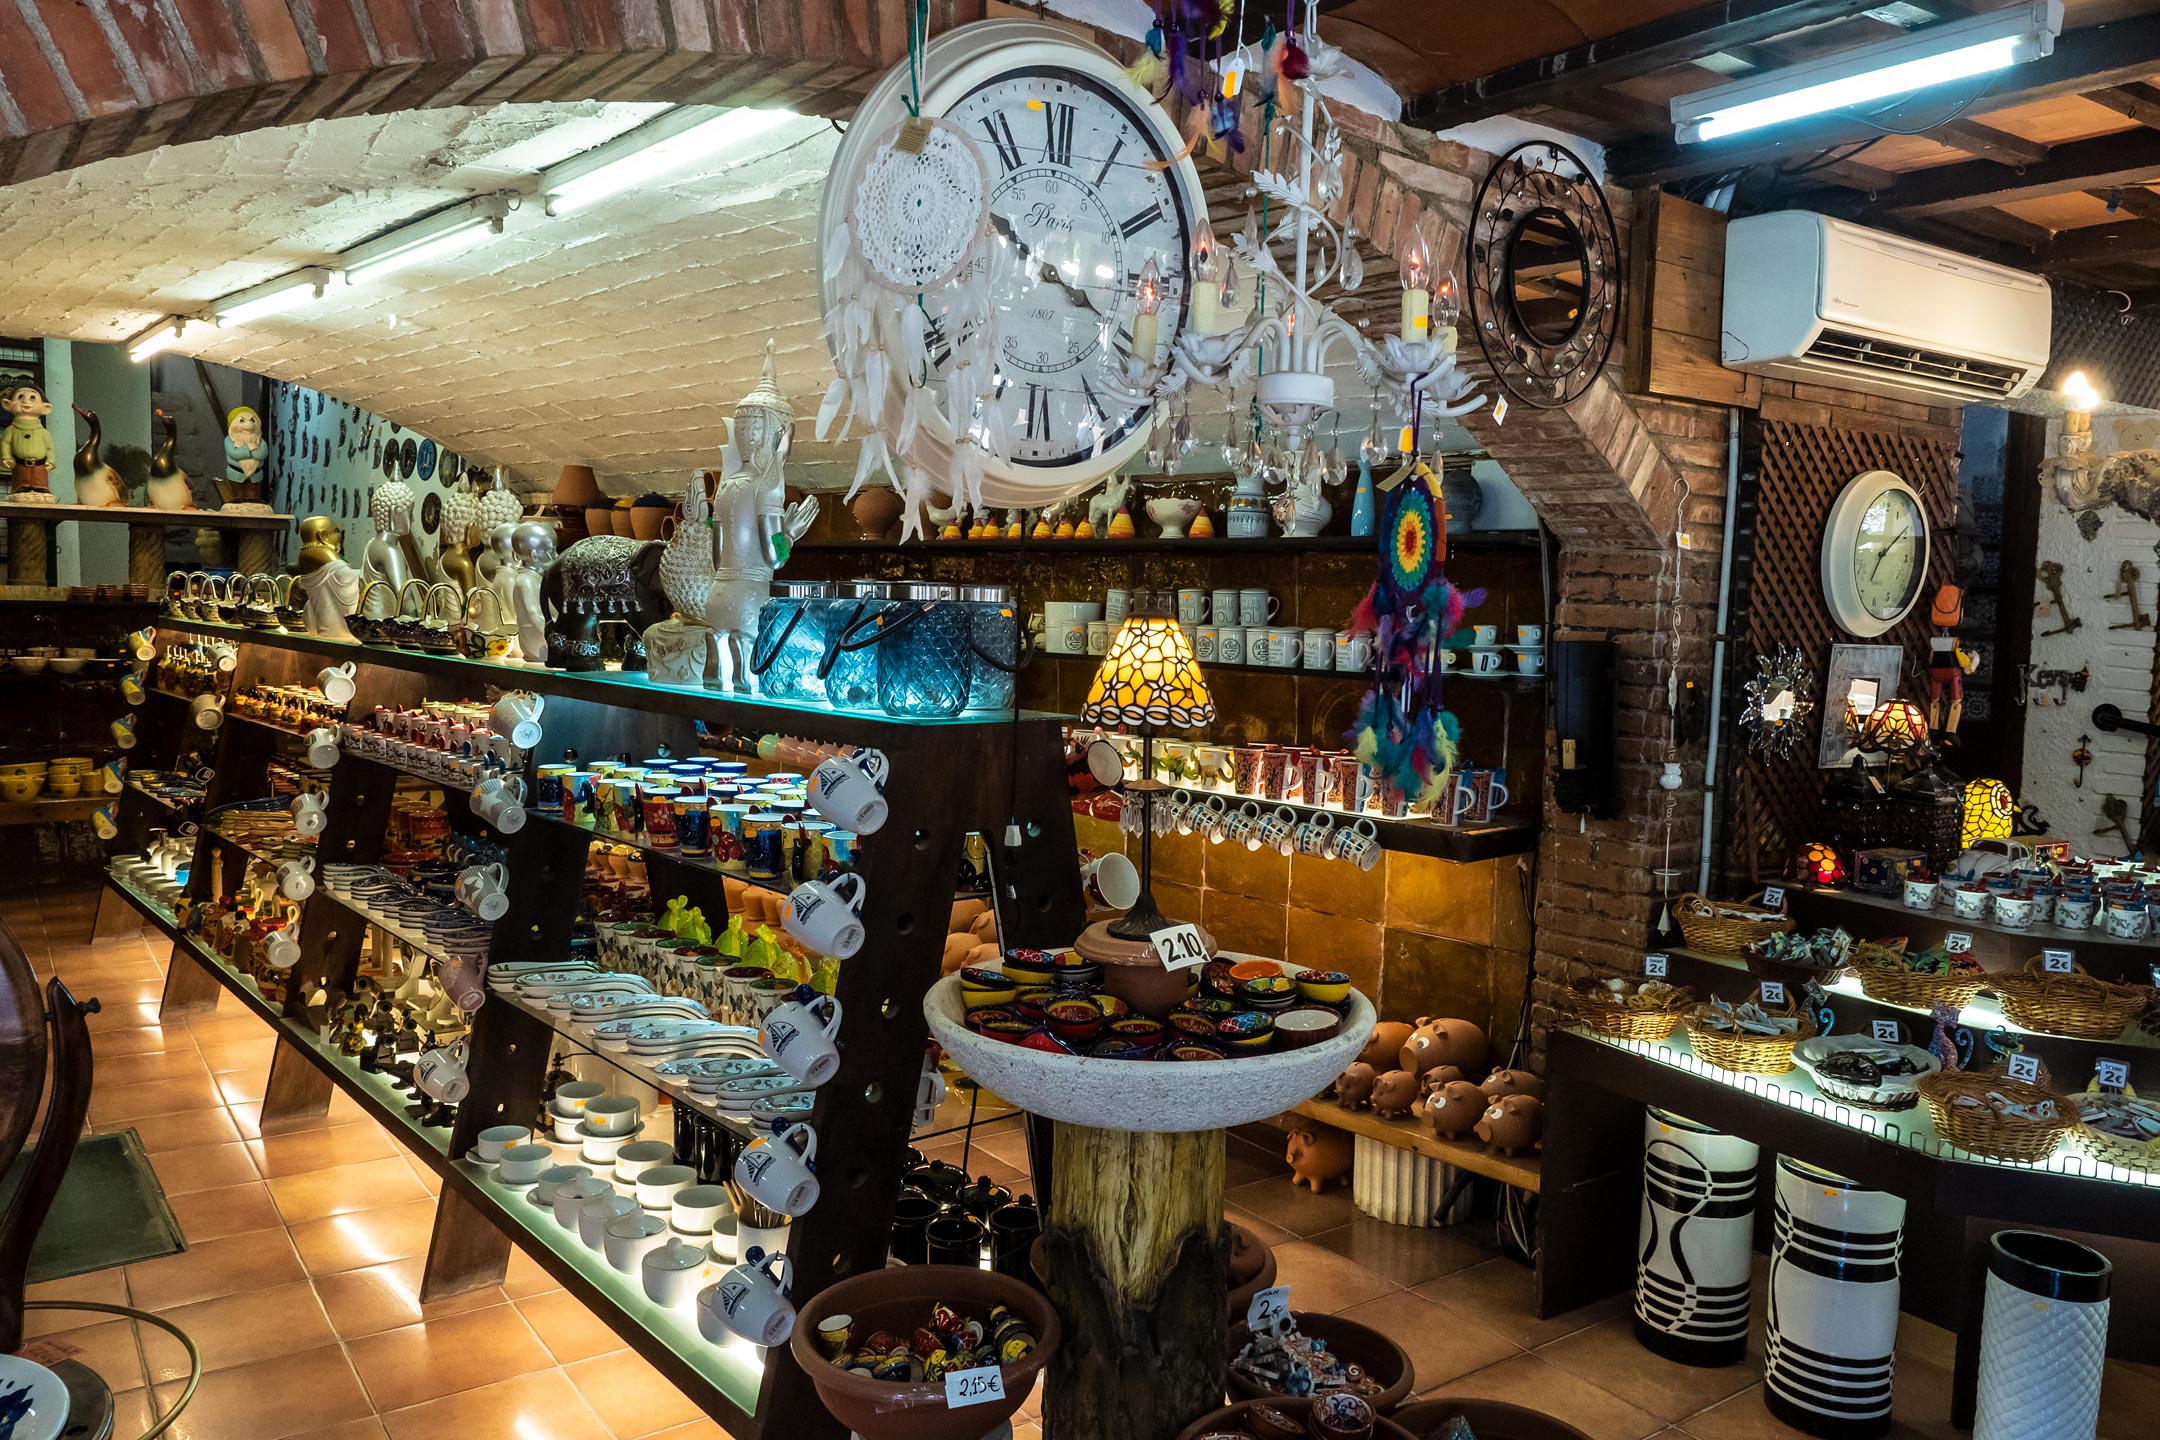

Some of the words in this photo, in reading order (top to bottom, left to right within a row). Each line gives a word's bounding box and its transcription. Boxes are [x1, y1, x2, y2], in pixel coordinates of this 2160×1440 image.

[1038, 101, 1079, 168] XII
[977, 109, 1027, 180] XI
[1045, 179, 1059, 194] 60
[1011, 187, 1026, 202] 55
[1080, 198, 1088, 212] 5
[1023, 202, 1075, 233] Paris
[1101, 231, 1111, 245] 10
[1030, 308, 1054, 320] 1807
[1004, 335, 1018, 349] 35
[1067, 341, 1080, 354] 25
[1037, 351, 1049, 364] 30
[1904, 554, 1909, 564] 3
[1766, 895, 1780, 904] 2€
[1161, 932, 1202, 963] 2.10
[1951, 941, 1966, 951] 2€
[1649, 964, 1664, 974] 2€
[2050, 959, 2069, 970] 2€
[1765, 990, 1781, 1000] 2€
[1877, 1028, 1896, 1039] 2€
[2015, 1057, 2034, 1066] Iman
[2012, 1063, 2033, 1078] 2€
[2103, 1071, 2123, 1084] 2€
[959, 1374, 1001, 1397] 2,15€
